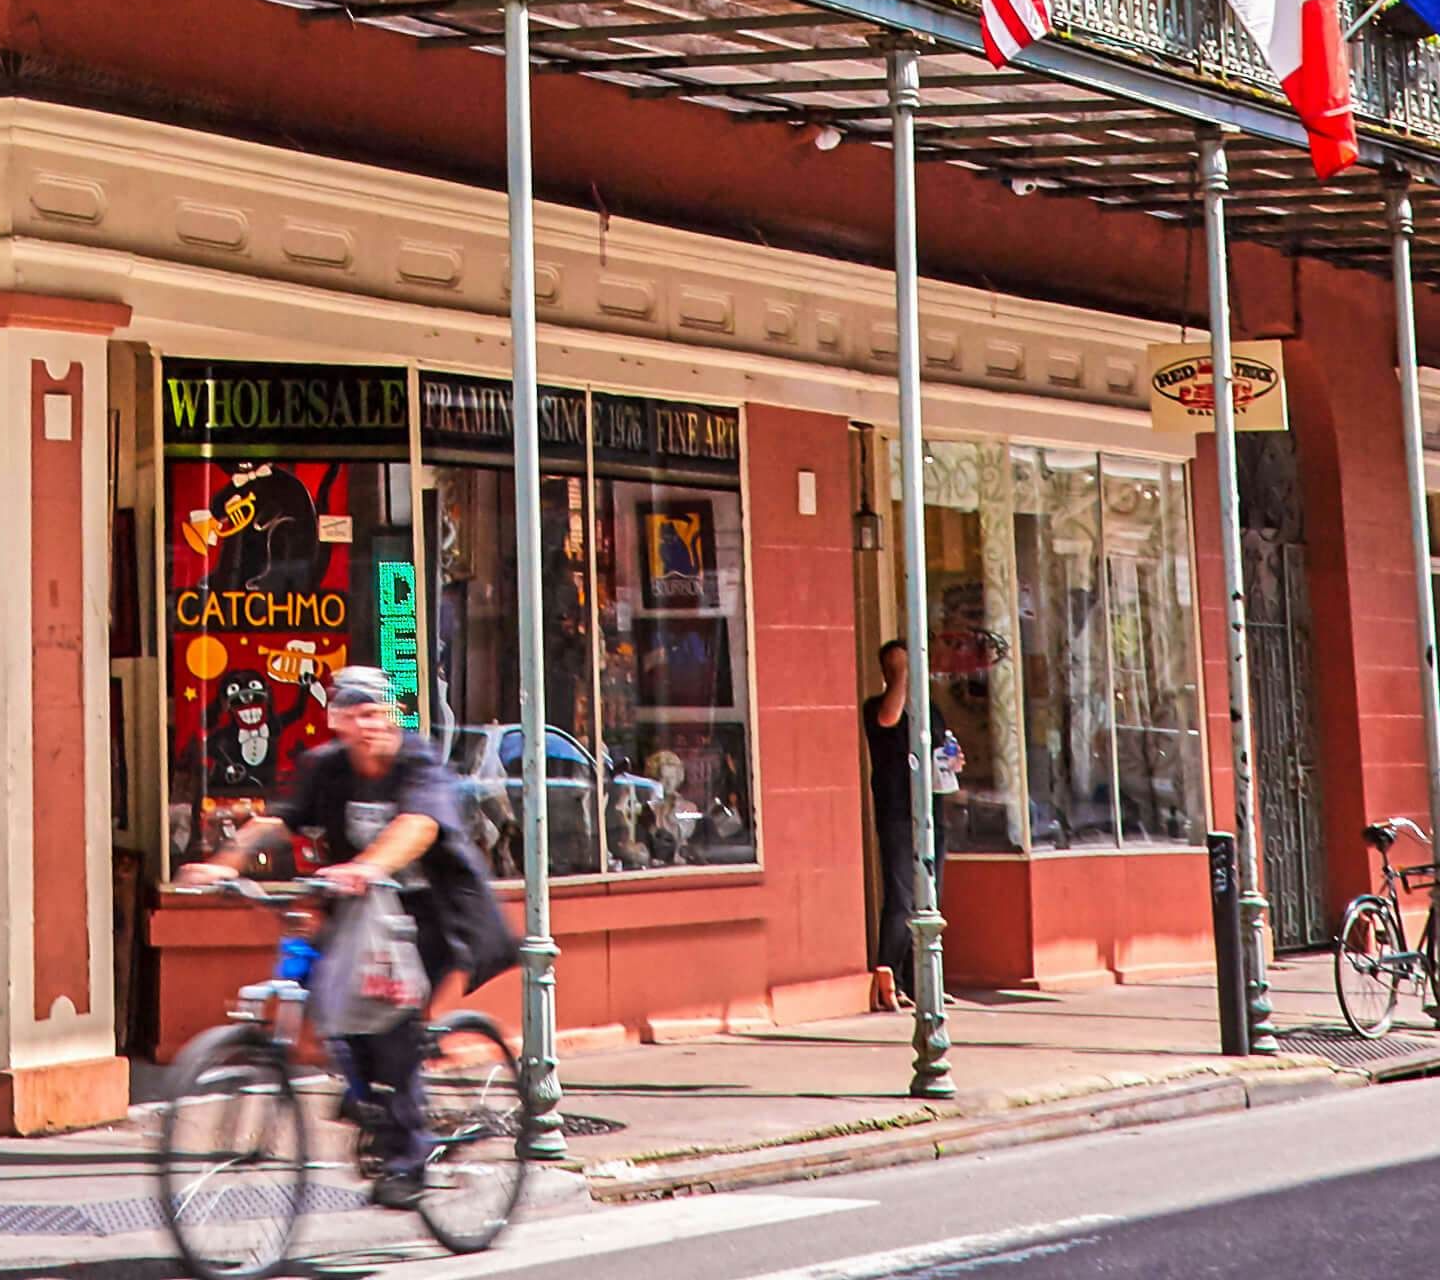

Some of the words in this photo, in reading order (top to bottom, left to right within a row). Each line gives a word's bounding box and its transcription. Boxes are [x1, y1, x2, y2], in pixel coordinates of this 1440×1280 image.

[1155, 363, 1197, 389] RED
[167, 378, 406, 430] WHOLESALE
[423, 381, 515, 438] FRAMIN
[655, 407, 699, 457] FINE
[703, 411, 738, 460] ART
[176, 591, 347, 627] CATCHMO
